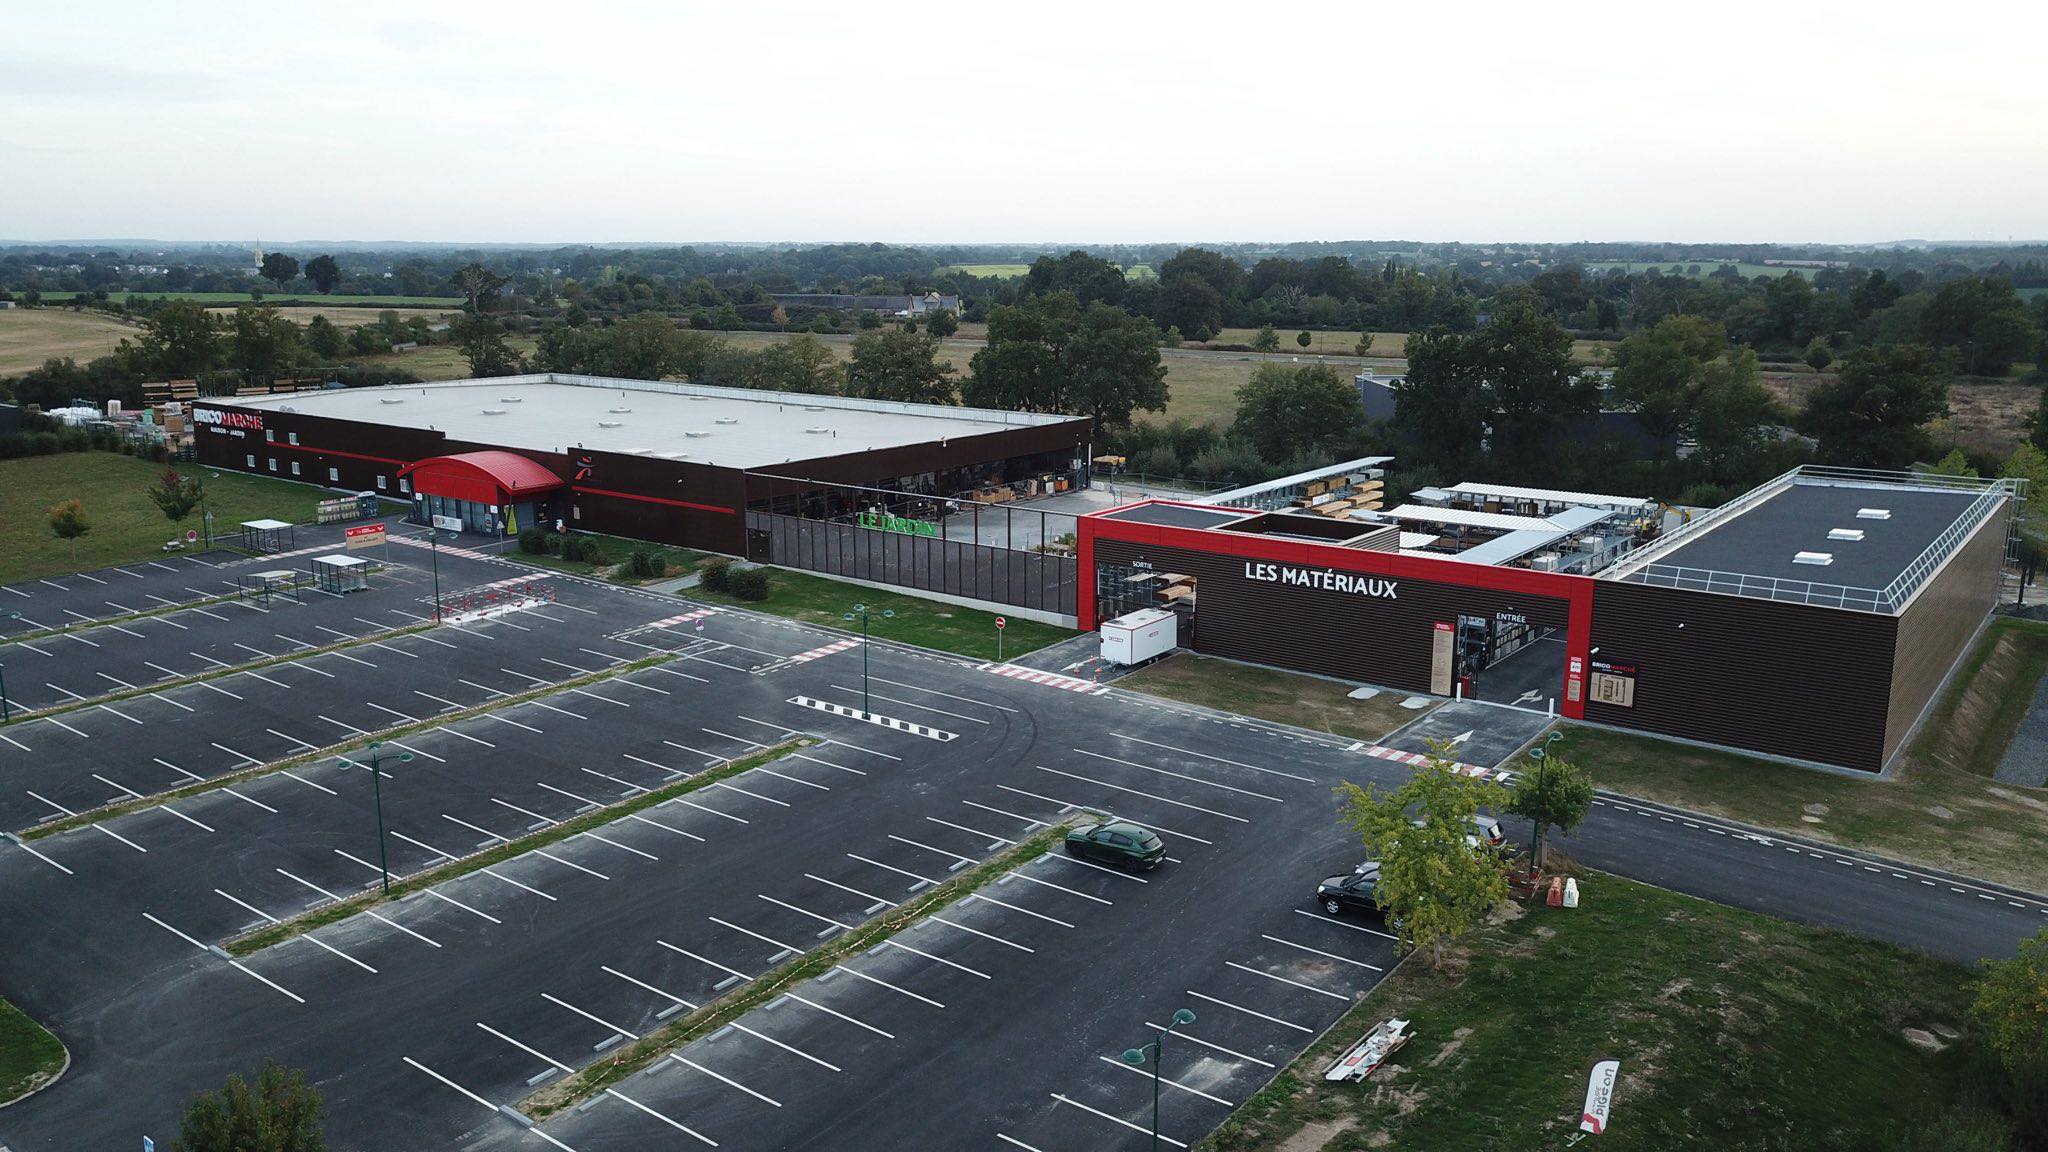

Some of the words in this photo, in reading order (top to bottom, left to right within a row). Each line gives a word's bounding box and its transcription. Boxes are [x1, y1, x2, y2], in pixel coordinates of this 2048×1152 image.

[860, 512, 876, 525] LE
[881, 515, 935, 534] JARDIN
[1132, 560, 1153, 569] SORTIE
[1245, 562, 1277, 582] LES
[1282, 568, 1398, 599] MATÉRIAUX
[1496, 612, 1526, 623] ENTRÉE
